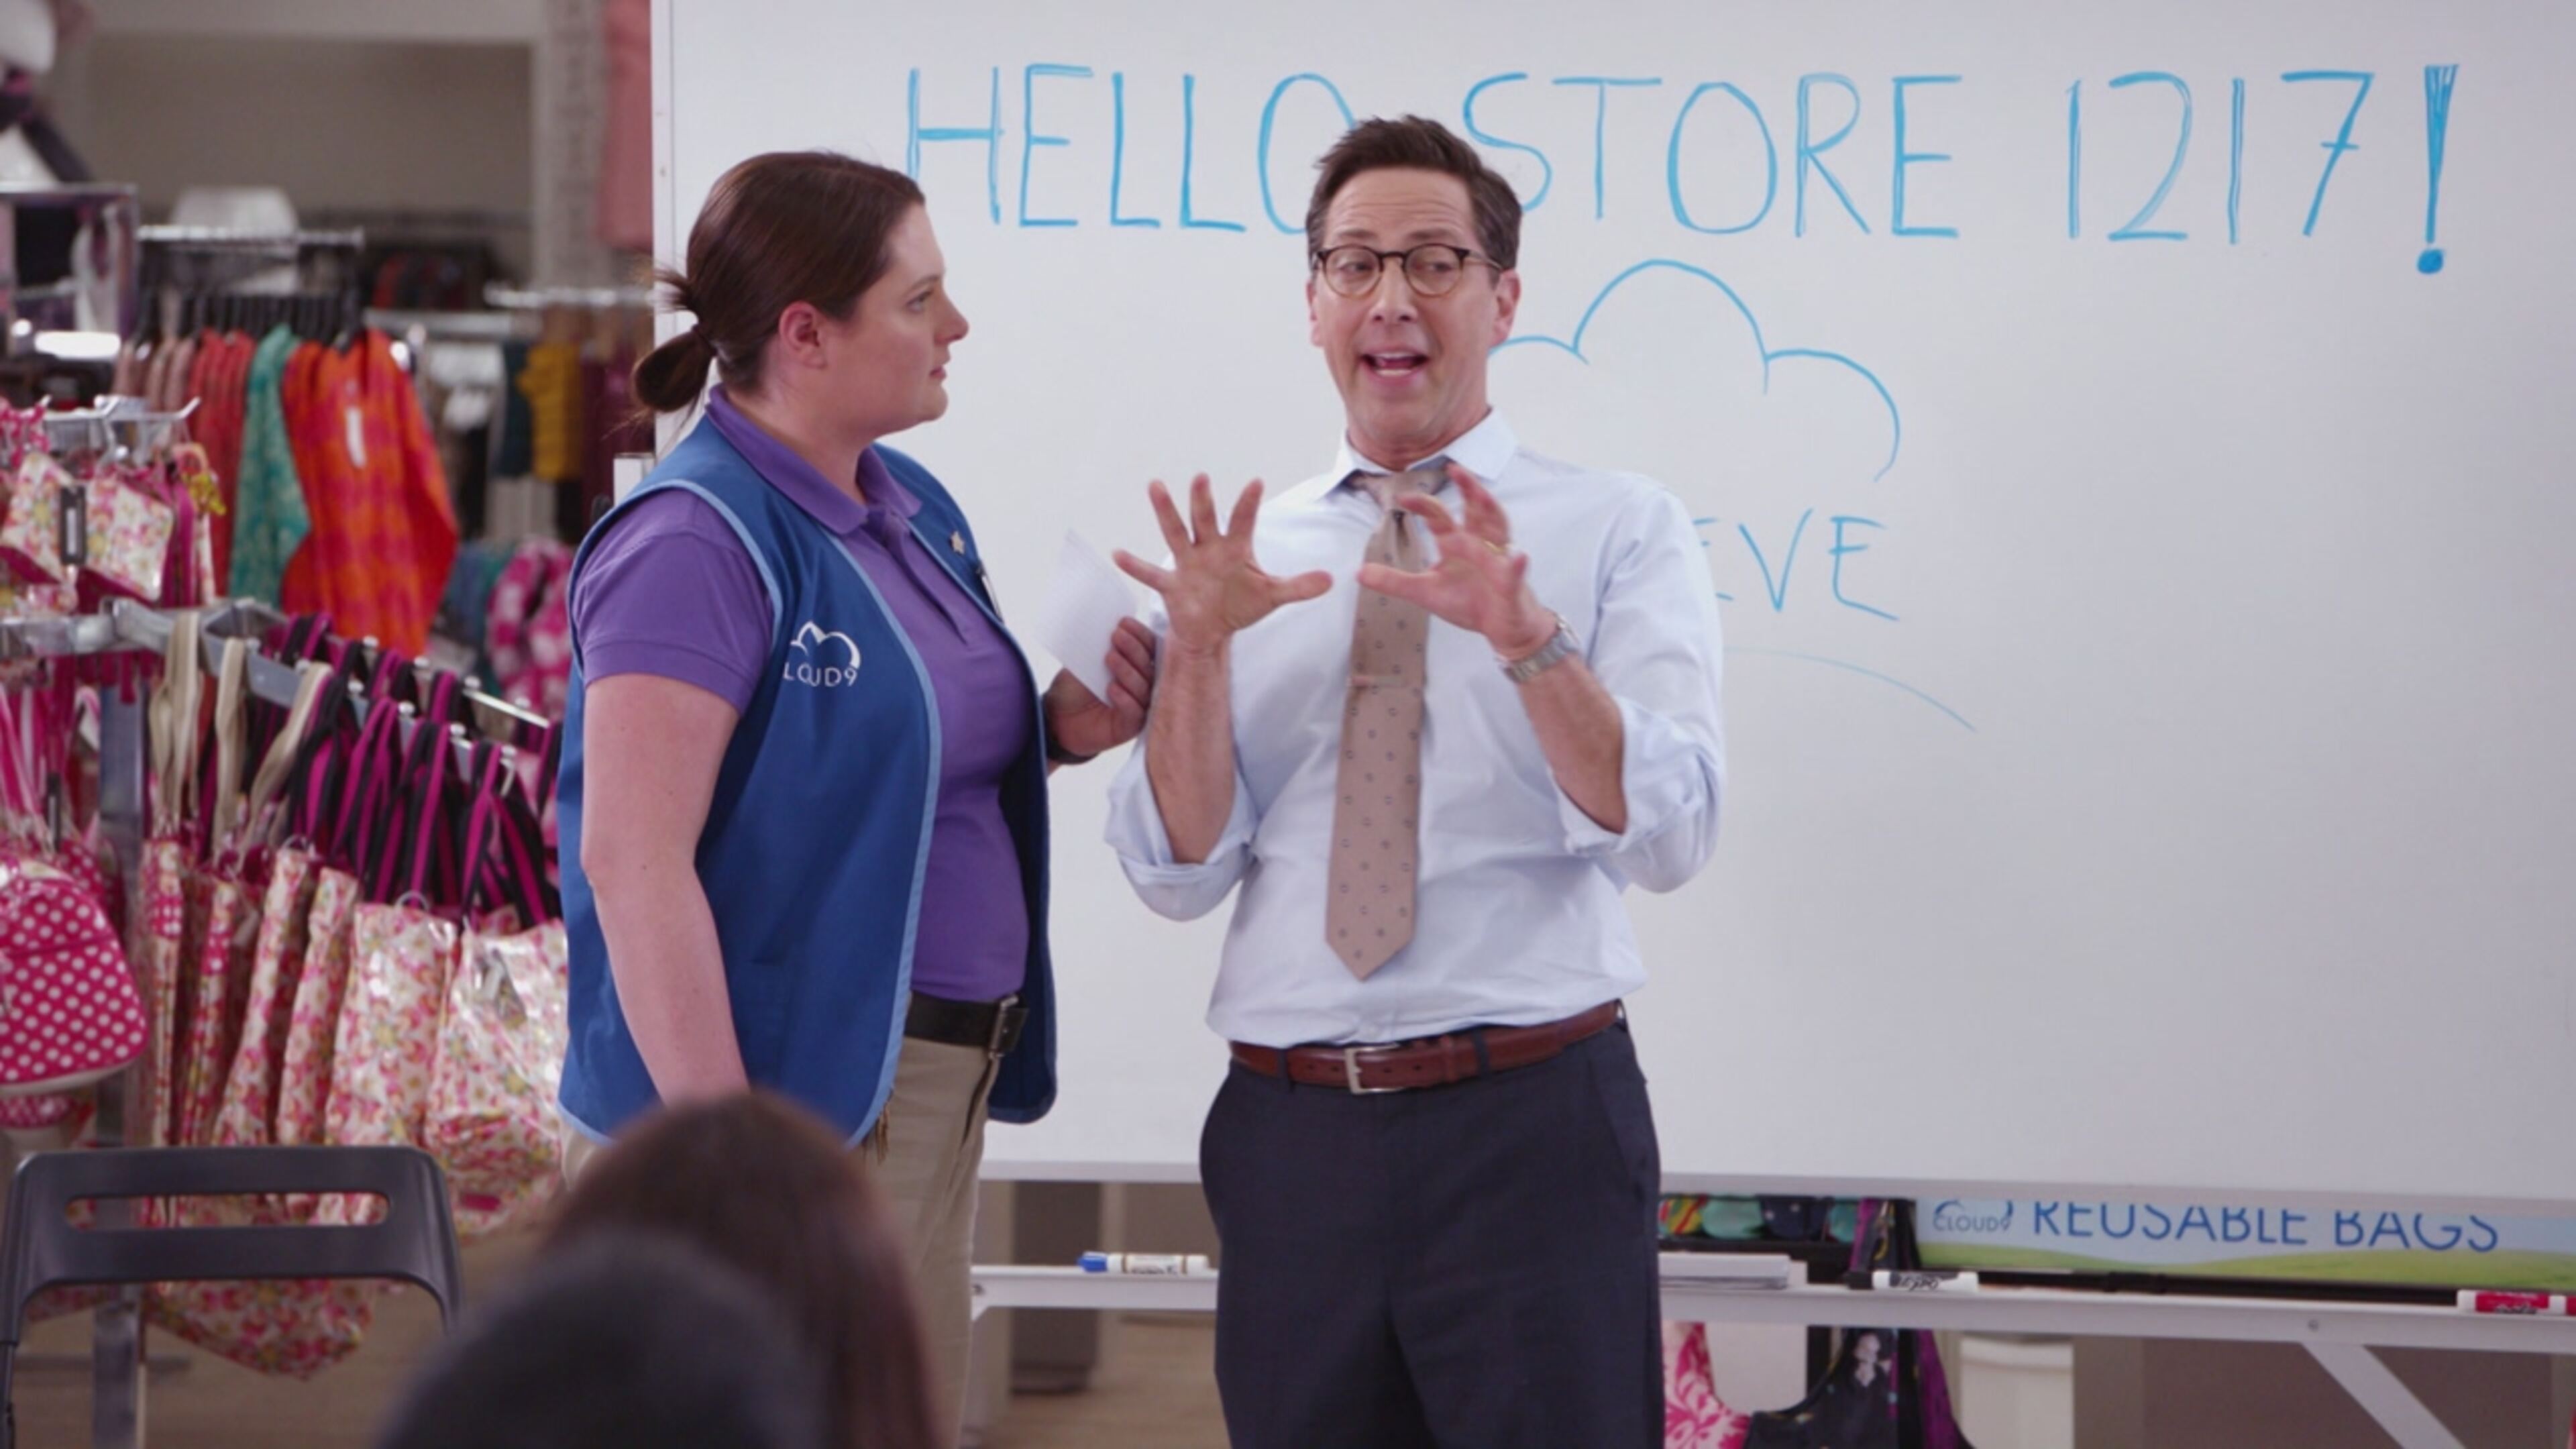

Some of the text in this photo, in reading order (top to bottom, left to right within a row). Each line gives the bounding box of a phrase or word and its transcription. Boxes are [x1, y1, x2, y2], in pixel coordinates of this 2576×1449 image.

[907, 64, 1356, 234] HELLO
[1462, 72, 1963, 239] STORE
[784, 662, 857, 687] LOUD9
[2034, 1201, 2308, 1245] REUSABLE
[2334, 1210, 2498, 1252] BAGS
